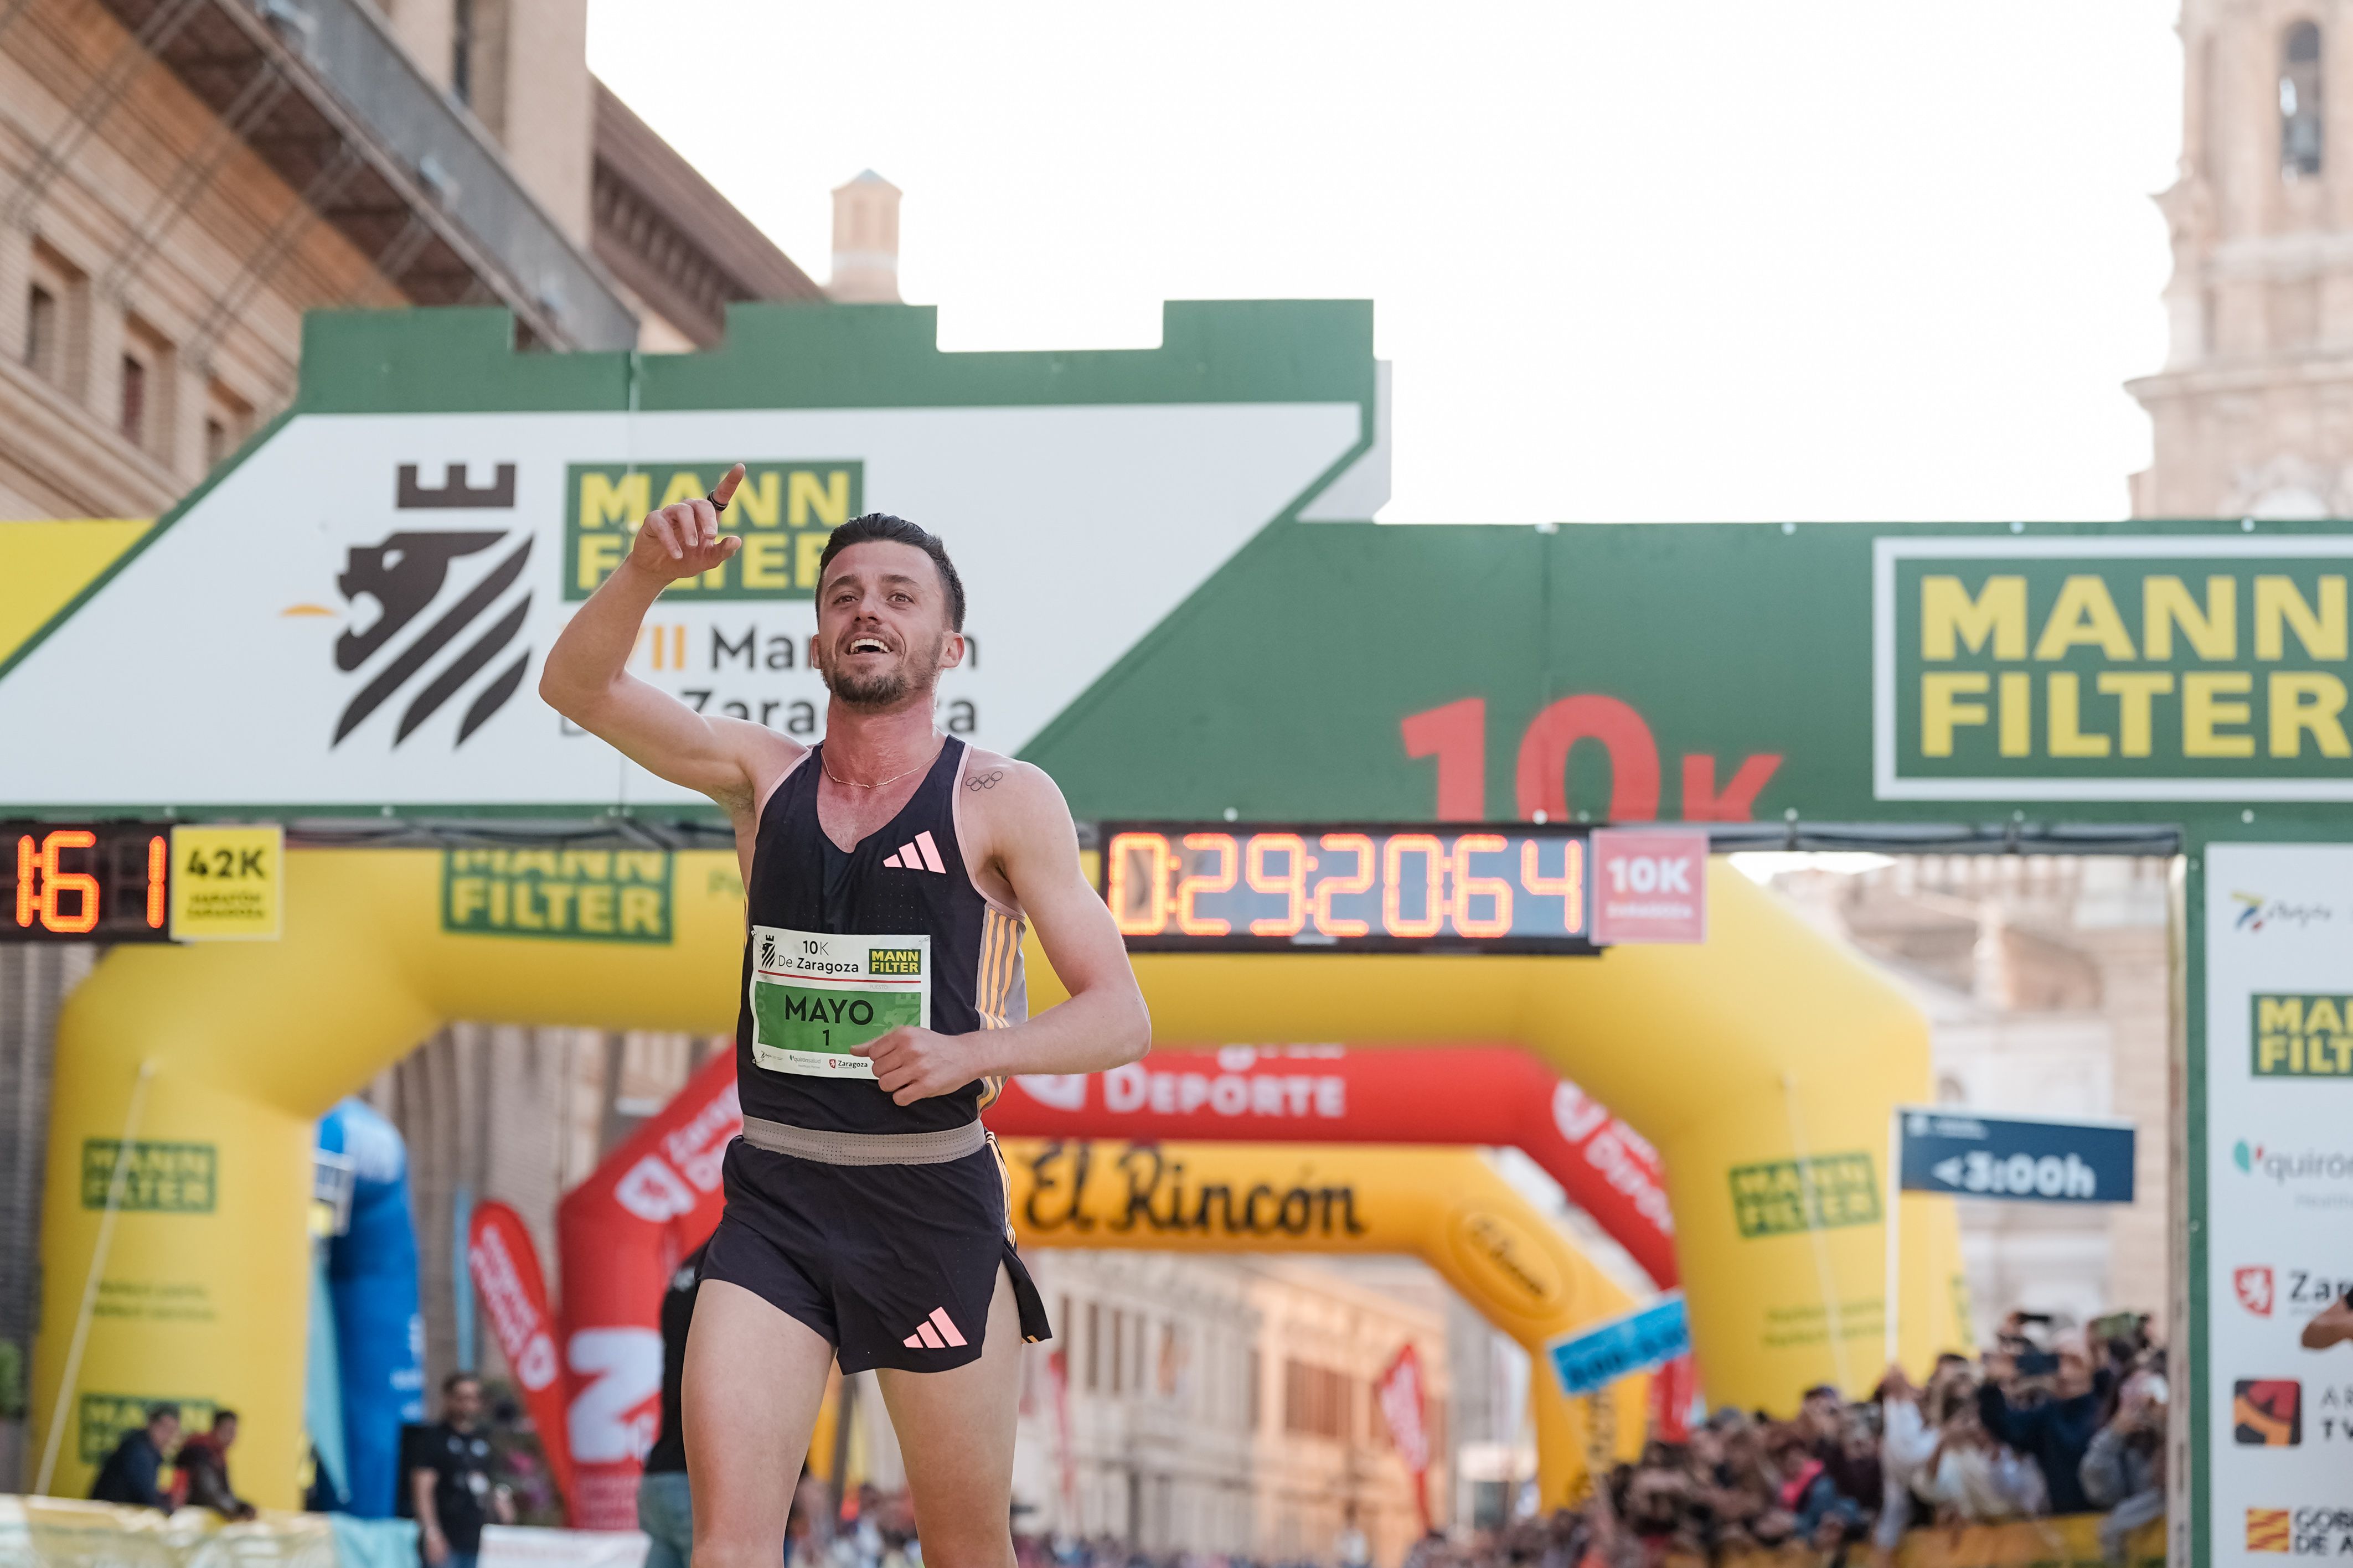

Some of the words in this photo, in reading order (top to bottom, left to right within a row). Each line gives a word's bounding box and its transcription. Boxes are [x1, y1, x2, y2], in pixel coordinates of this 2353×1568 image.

[1921, 575, 2347, 661] MANN
[1921, 671, 2352, 758] FILTER
[187, 849, 265, 878] 42K
[1607, 857, 1691, 894] 10K
[451, 877, 662, 934] FILTER
[803, 940, 829, 956] 10K
[871, 951, 919, 961] MANN
[778, 955, 793, 967] De
[797, 958, 859, 974] Zaragoza
[871, 961, 919, 972] FILTER
[785, 994, 874, 1025] MAYO
[2258, 997, 2353, 1034] MA
[822, 1029, 829, 1046] 1
[838, 1060, 868, 1069] Zaragoza
[1023, 1141, 1095, 1232] El
[1112, 1143, 1368, 1235] Rincón
